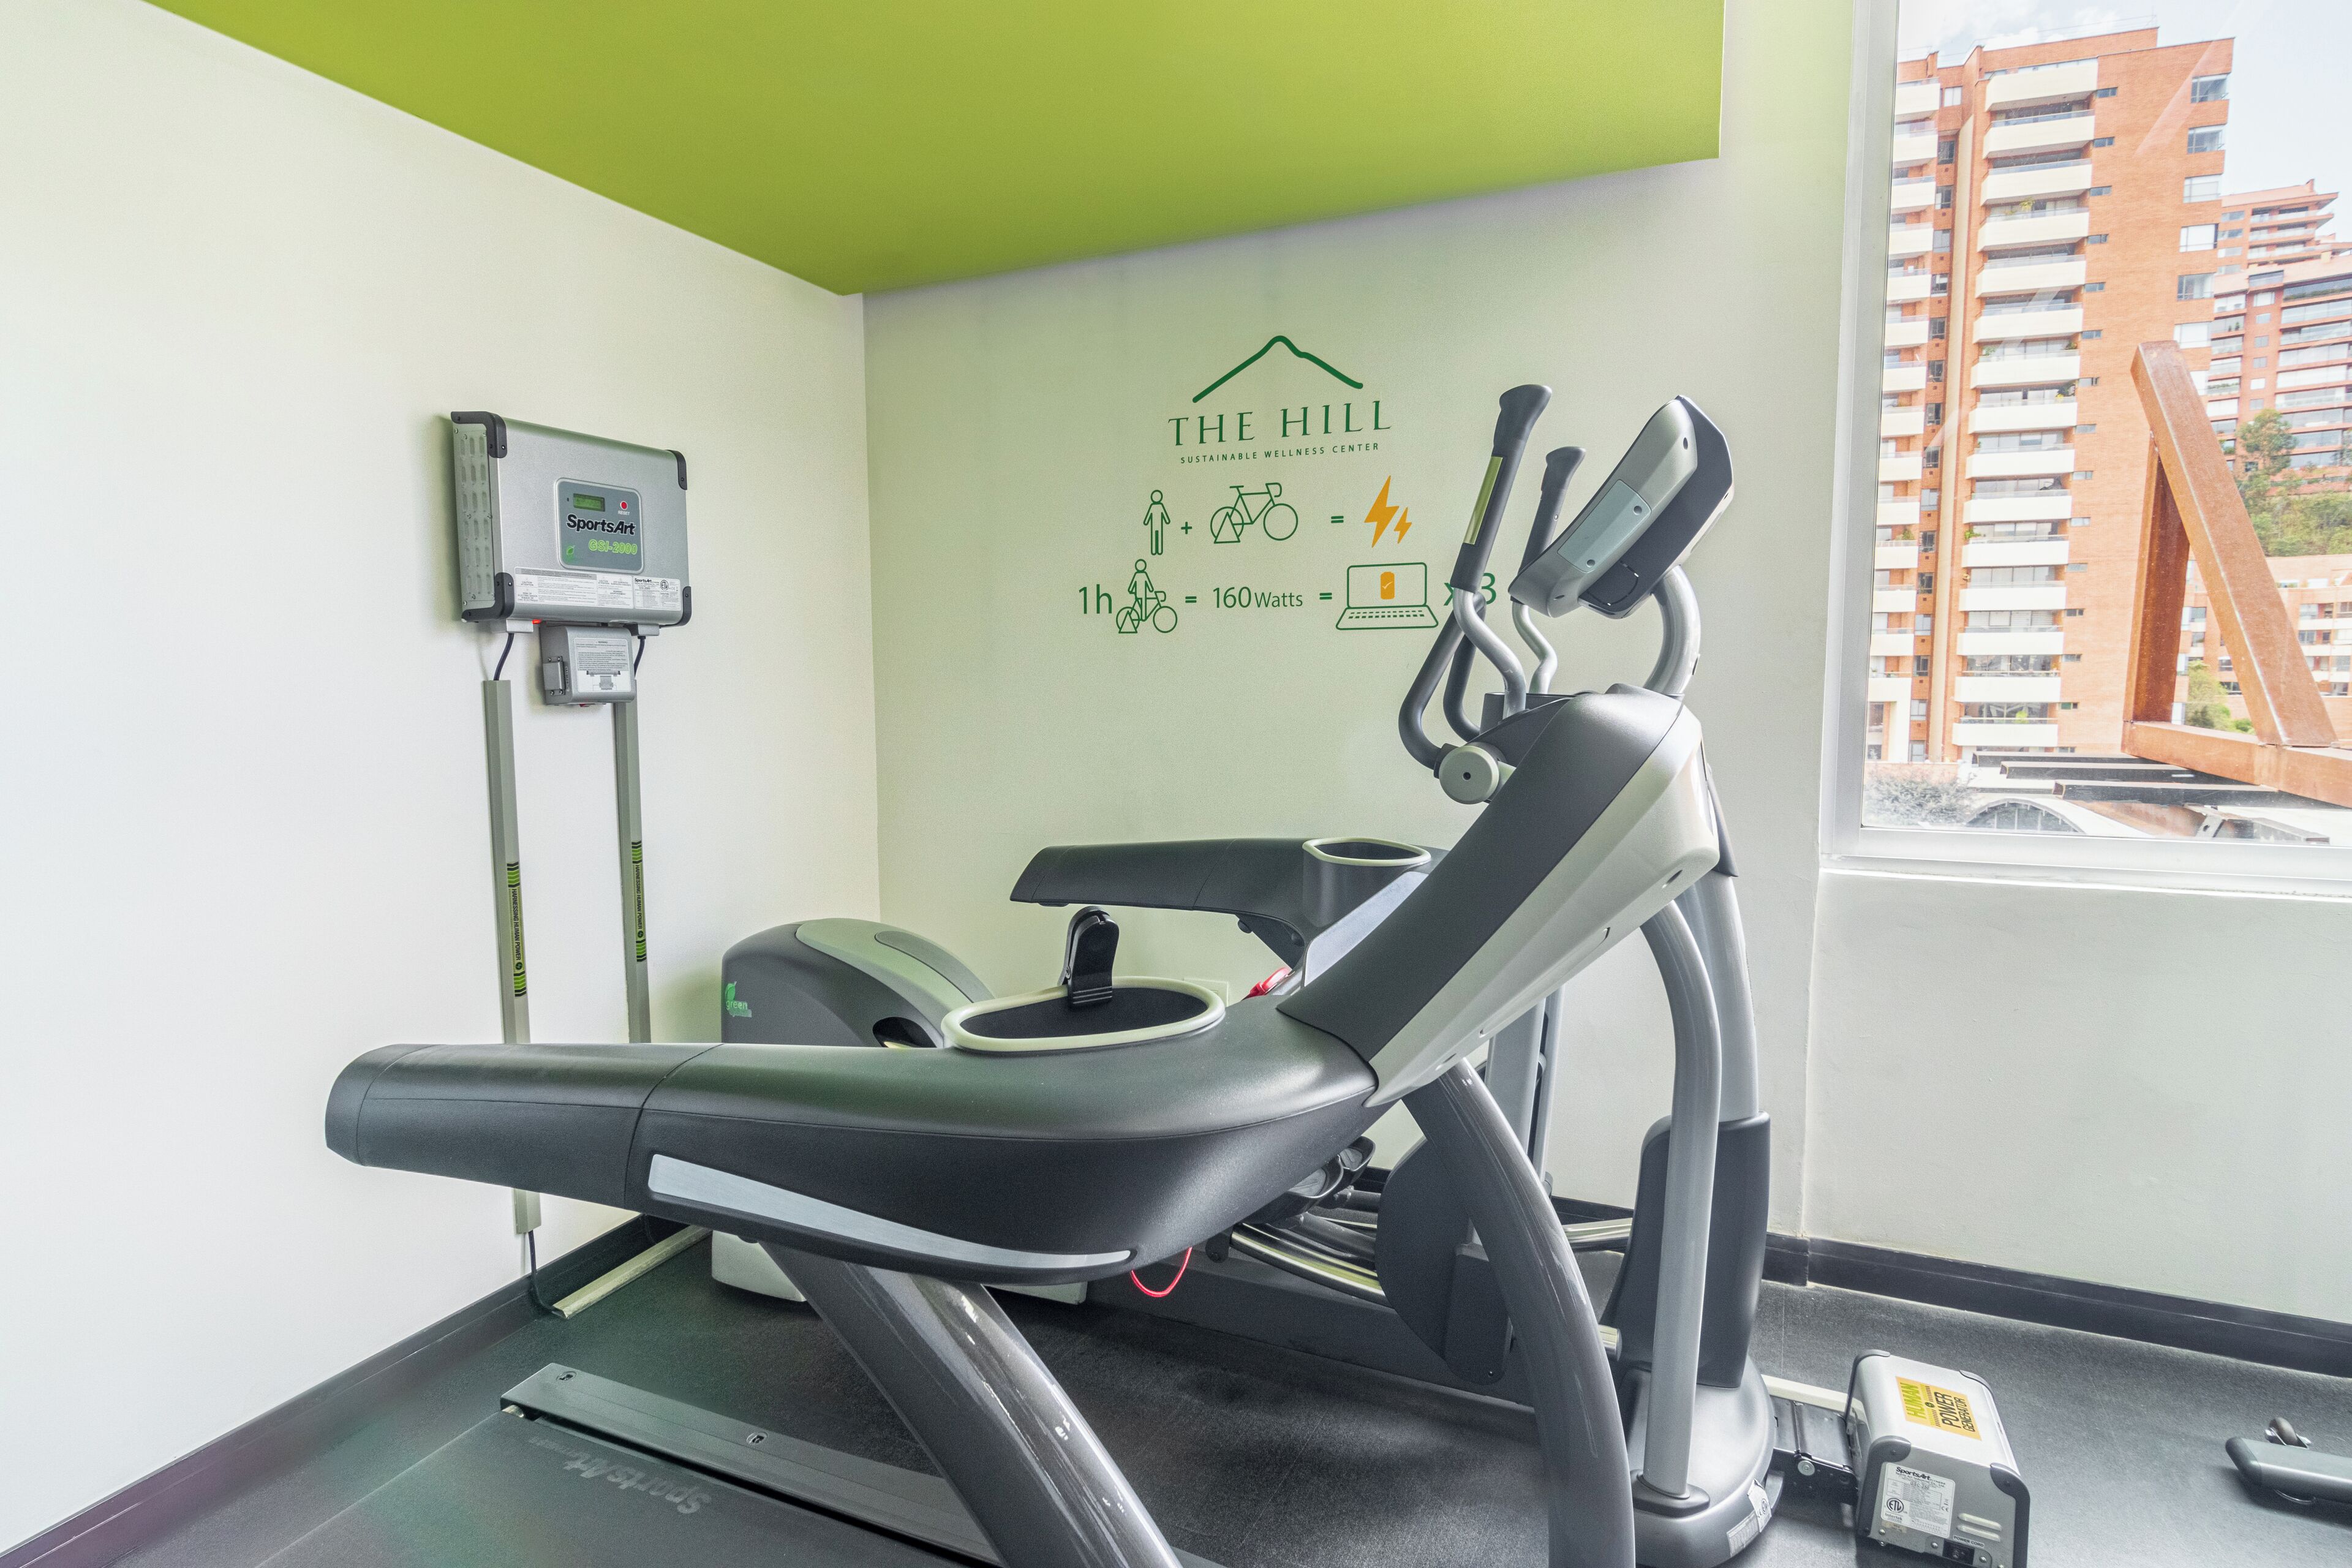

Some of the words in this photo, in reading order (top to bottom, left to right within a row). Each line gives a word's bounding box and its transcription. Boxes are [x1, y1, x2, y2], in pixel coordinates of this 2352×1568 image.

[1168, 412, 1254, 446] THE
[1280, 401, 1392, 437] HILL
[1180, 452, 1258, 464] SUSTAINABLE
[1264, 447, 1325, 458] WELLNESS
[1332, 442, 1379, 453] CENTER
[567, 513, 636, 535] SportsArt
[589, 539, 638, 554] GSI-2000
[1078, 583, 1113, 614] 1h
[726, 1000, 748, 1010] green
[1900, 1382, 1927, 1420] HUMAN
[1934, 1392, 1962, 1428] POWER
[1954, 1396, 1975, 1432] GENERATOR
[563, 1452, 712, 1514] SportsArt
[1896, 1466, 1930, 1480] SportsArt
[1953, 1536, 1970, 1544] POWER
[1970, 1539, 1985, 1547] CORD
